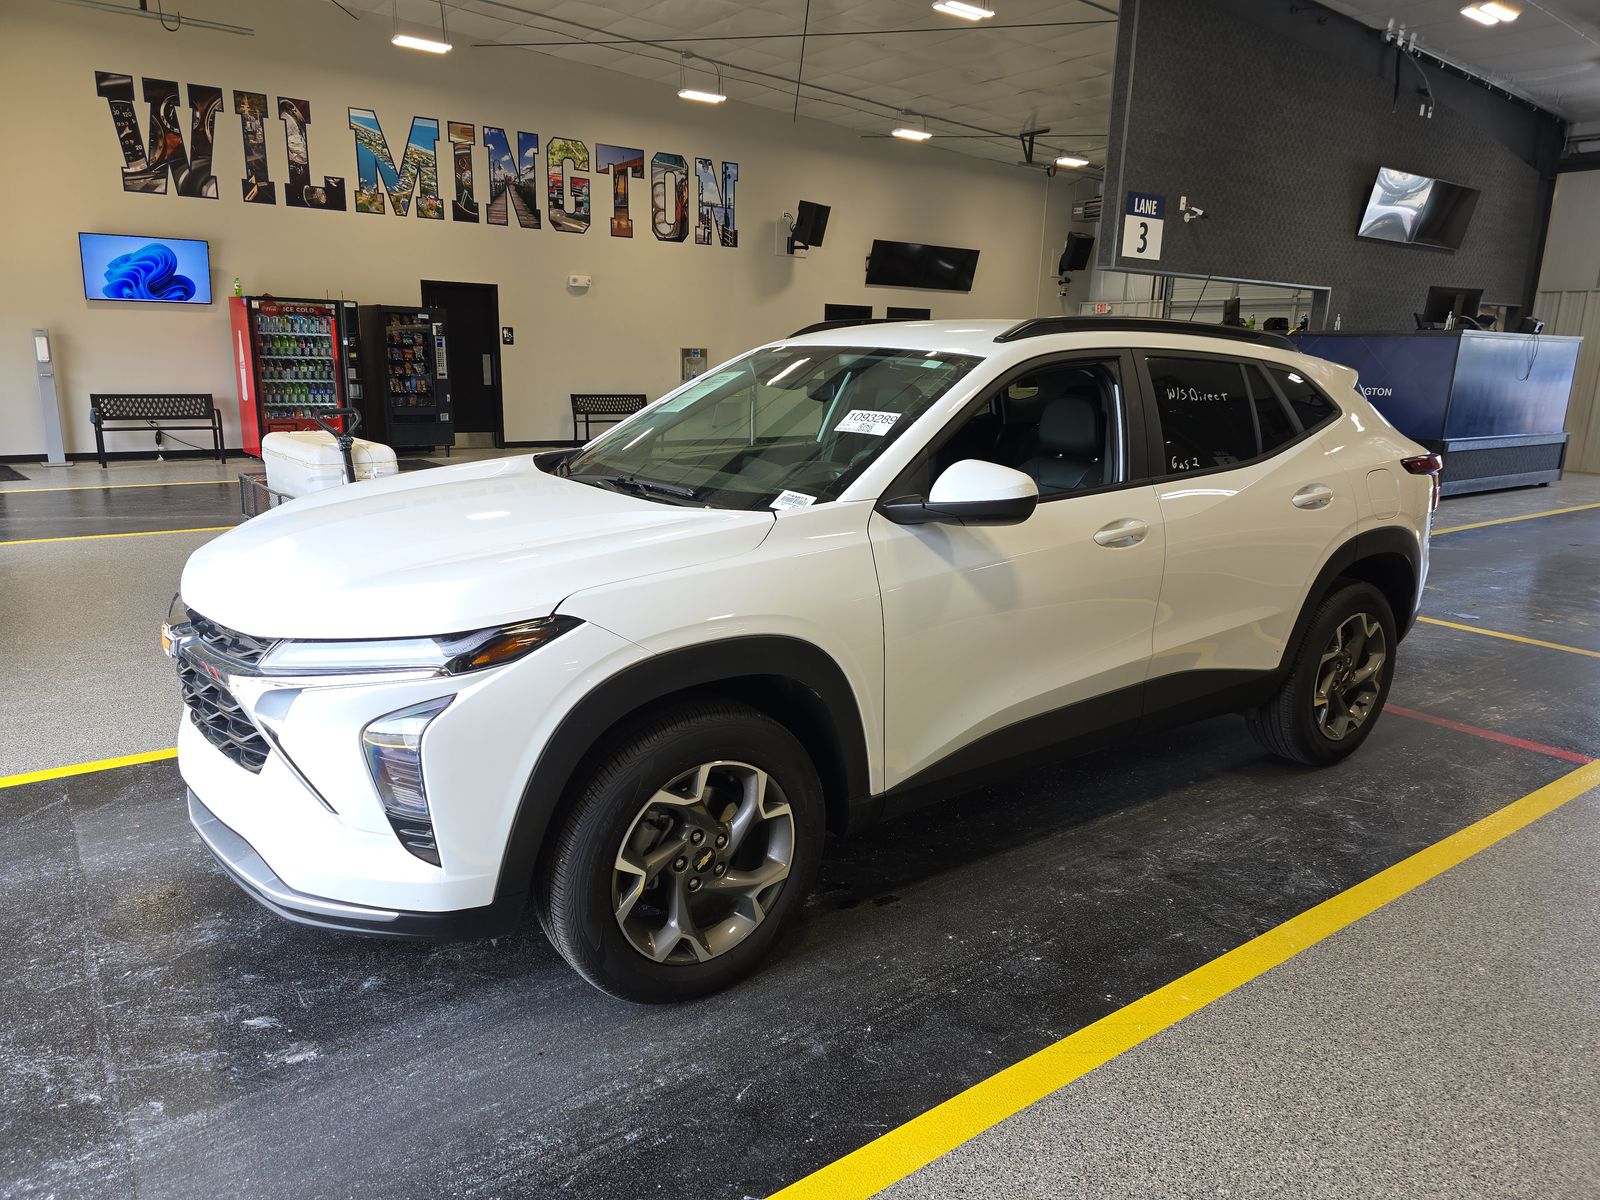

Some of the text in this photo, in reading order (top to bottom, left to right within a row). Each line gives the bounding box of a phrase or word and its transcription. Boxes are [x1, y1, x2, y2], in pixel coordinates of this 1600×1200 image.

[95, 71, 739, 248] WILMINGTON
[1134, 197, 1158, 215] LANE
[1136, 222, 1148, 253] 3
[849, 412, 899, 424] 1093289
[1193, 457, 1200, 467] 2
